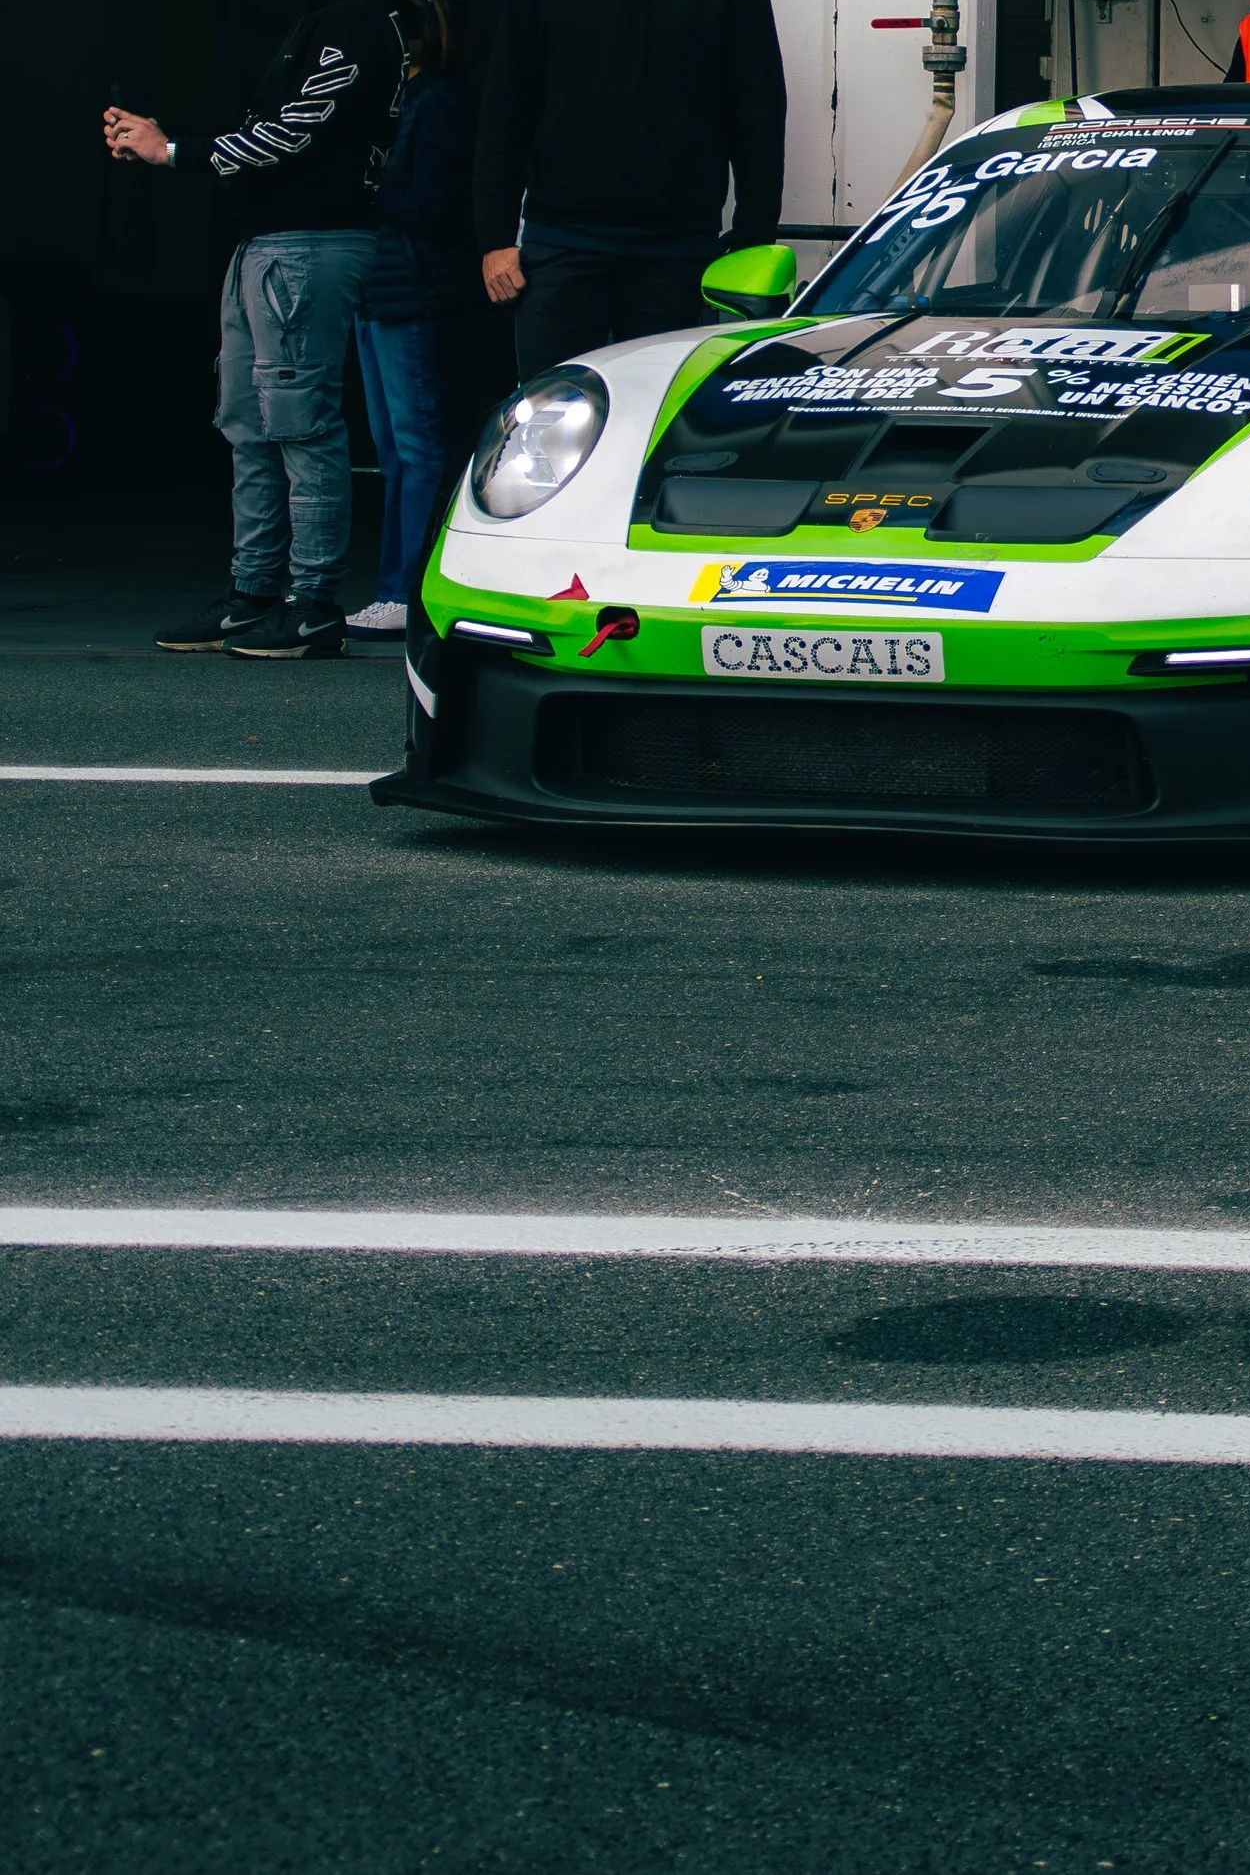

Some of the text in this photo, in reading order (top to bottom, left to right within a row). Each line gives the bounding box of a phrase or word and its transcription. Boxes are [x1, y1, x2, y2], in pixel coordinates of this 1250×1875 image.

[1050, 118, 1247, 131] PORSCHE
[1043, 129, 1195, 142] SPRINT CHALLENGE
[1037, 138, 1097, 149] IBERICA
[901, 164, 953, 200] D.
[866, 181, 980, 245] 75
[803, 365, 940, 379] CON UNA
[722, 376, 938, 392] RENTABILIDAD
[936, 367, 1039, 399] 5
[860, 388, 916, 400] DEL
[1056, 391, 1108, 406] UN
[1091, 382, 1242, 402] NECESITA
[994, 408, 1065, 417] RENTABILIDAD
[824, 493, 932, 507] SPEC
[776, 574, 964, 595] MICHELIN
[712, 632, 931, 676] CASCAIS
